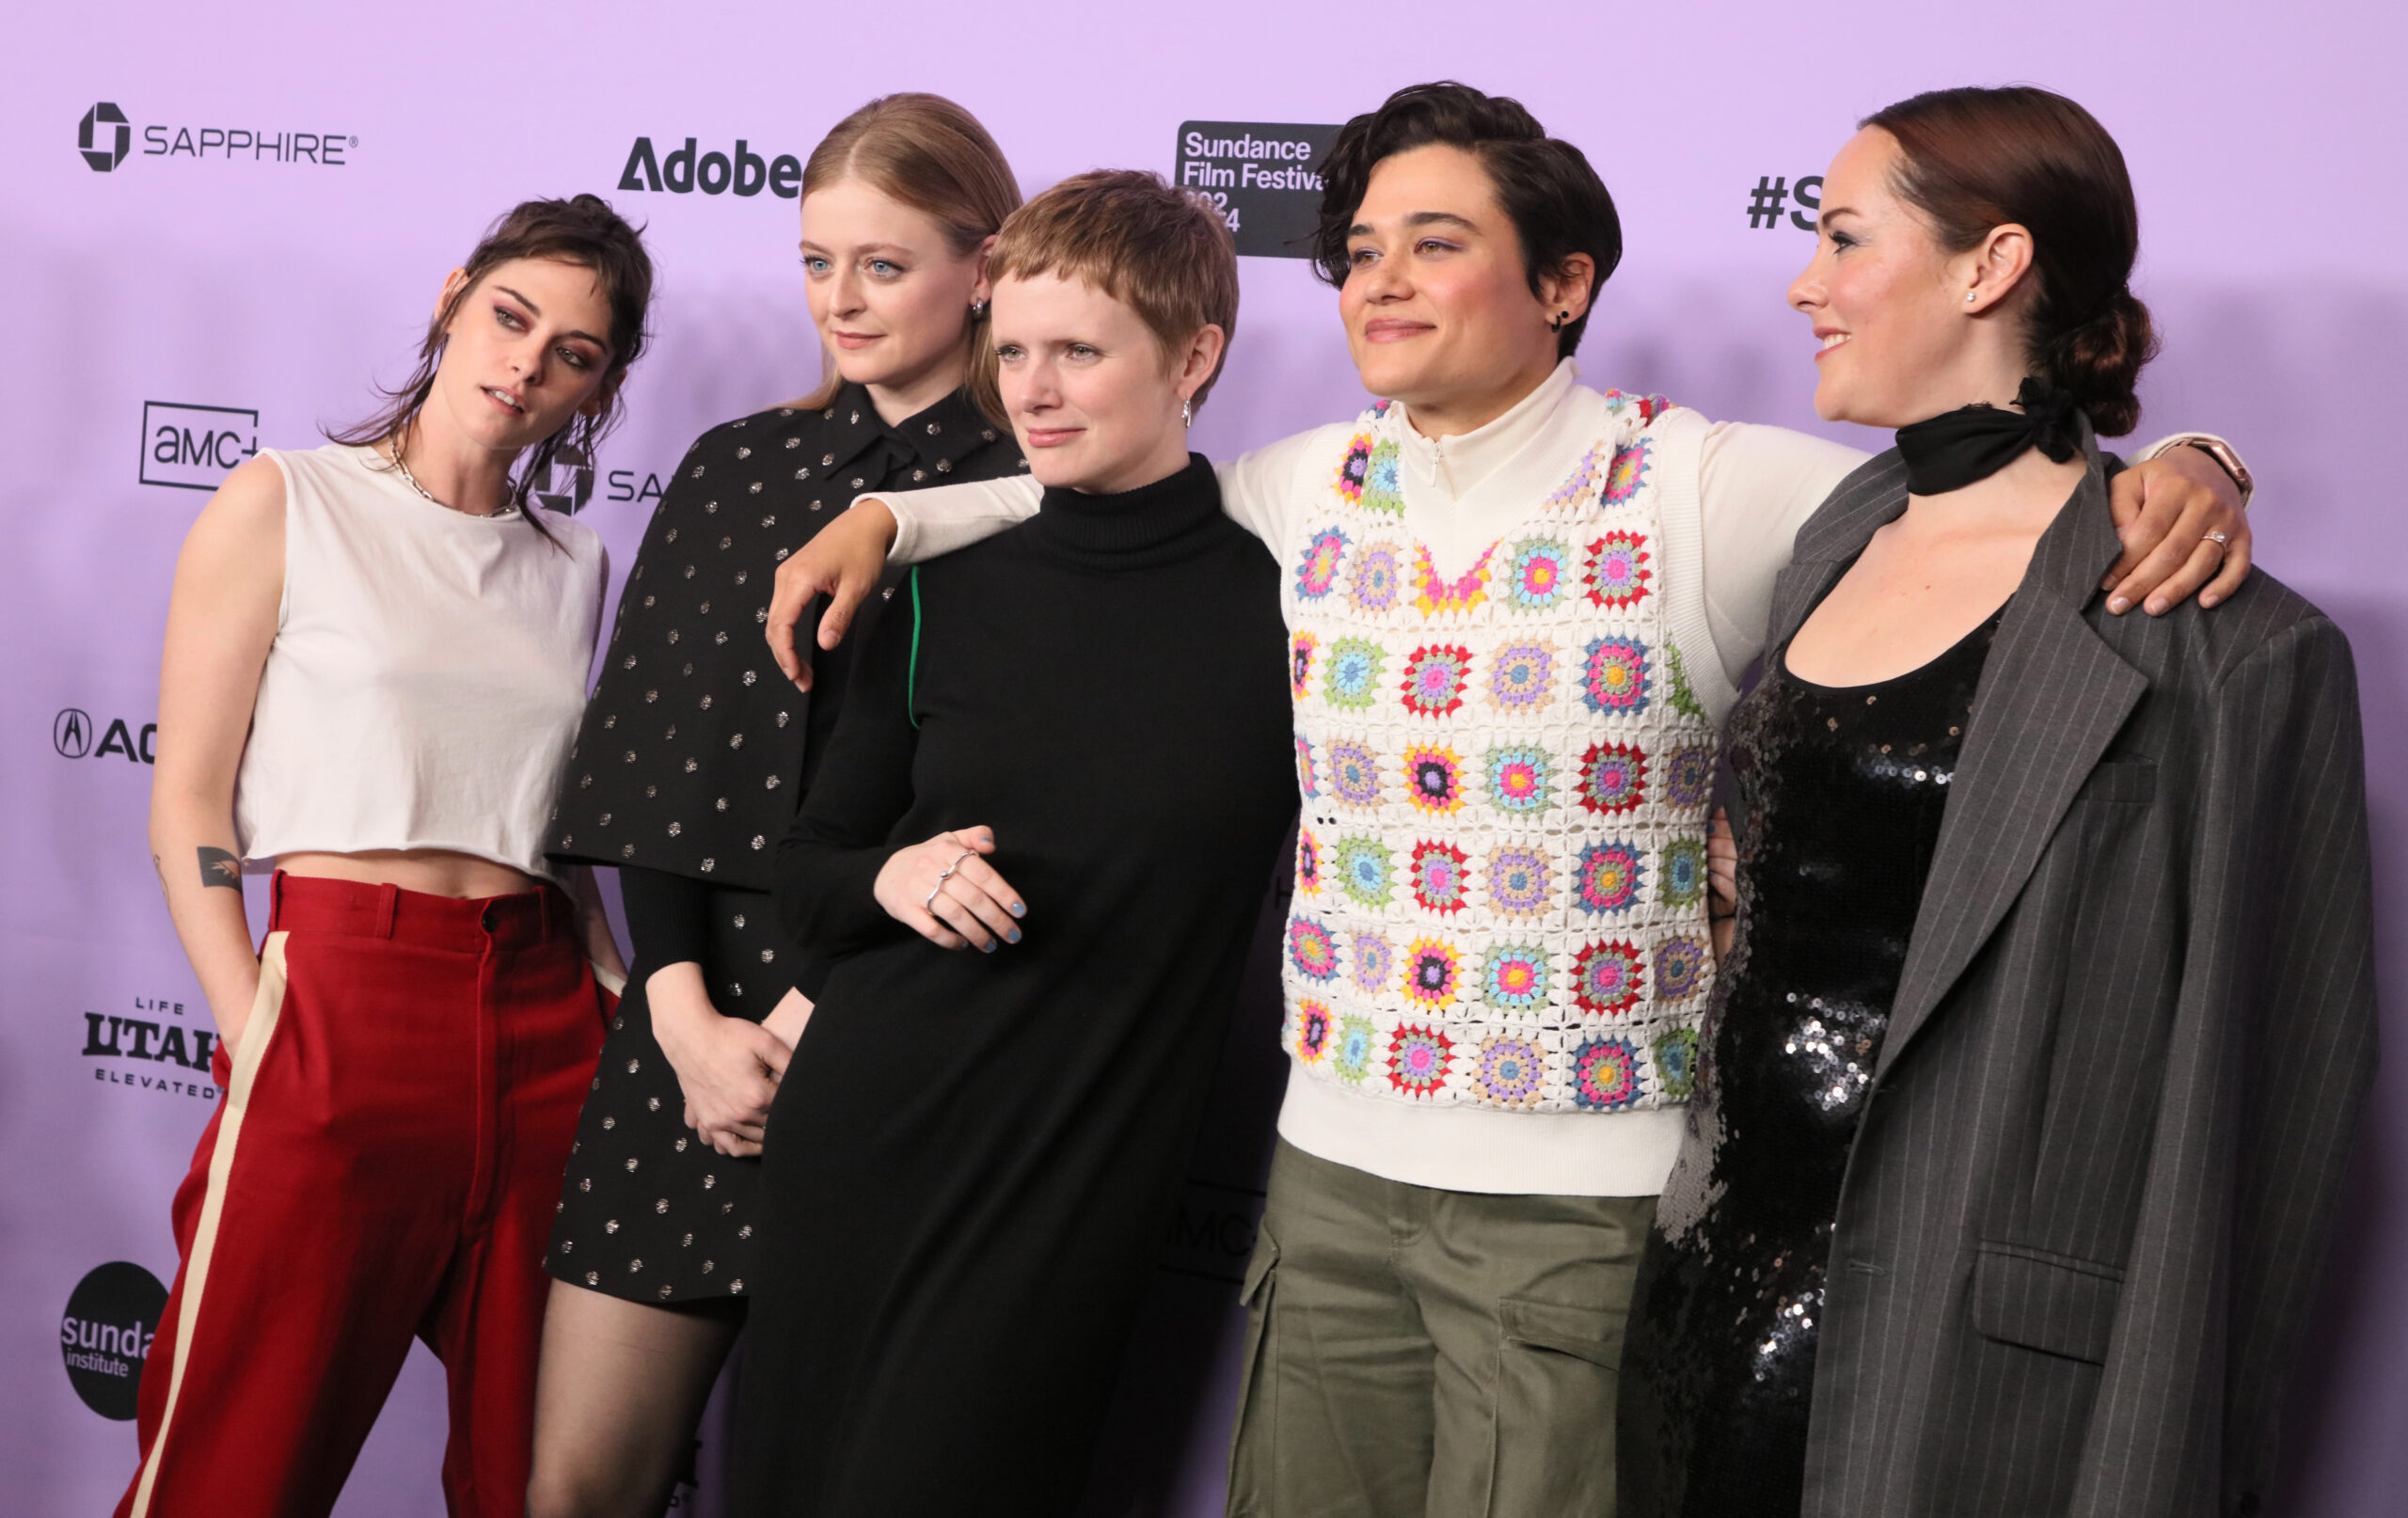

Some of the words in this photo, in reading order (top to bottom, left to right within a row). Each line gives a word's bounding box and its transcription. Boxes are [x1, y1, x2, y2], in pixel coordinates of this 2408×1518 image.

[1184, 132, 1311, 160] Sundance
[617, 136, 801, 198] Adobe
[1183, 161, 1235, 187] Film
[135, 997, 184, 1015] LIFE
[95, 1068, 214, 1099] ELEVATED
[67, 1347, 129, 1377] institute
